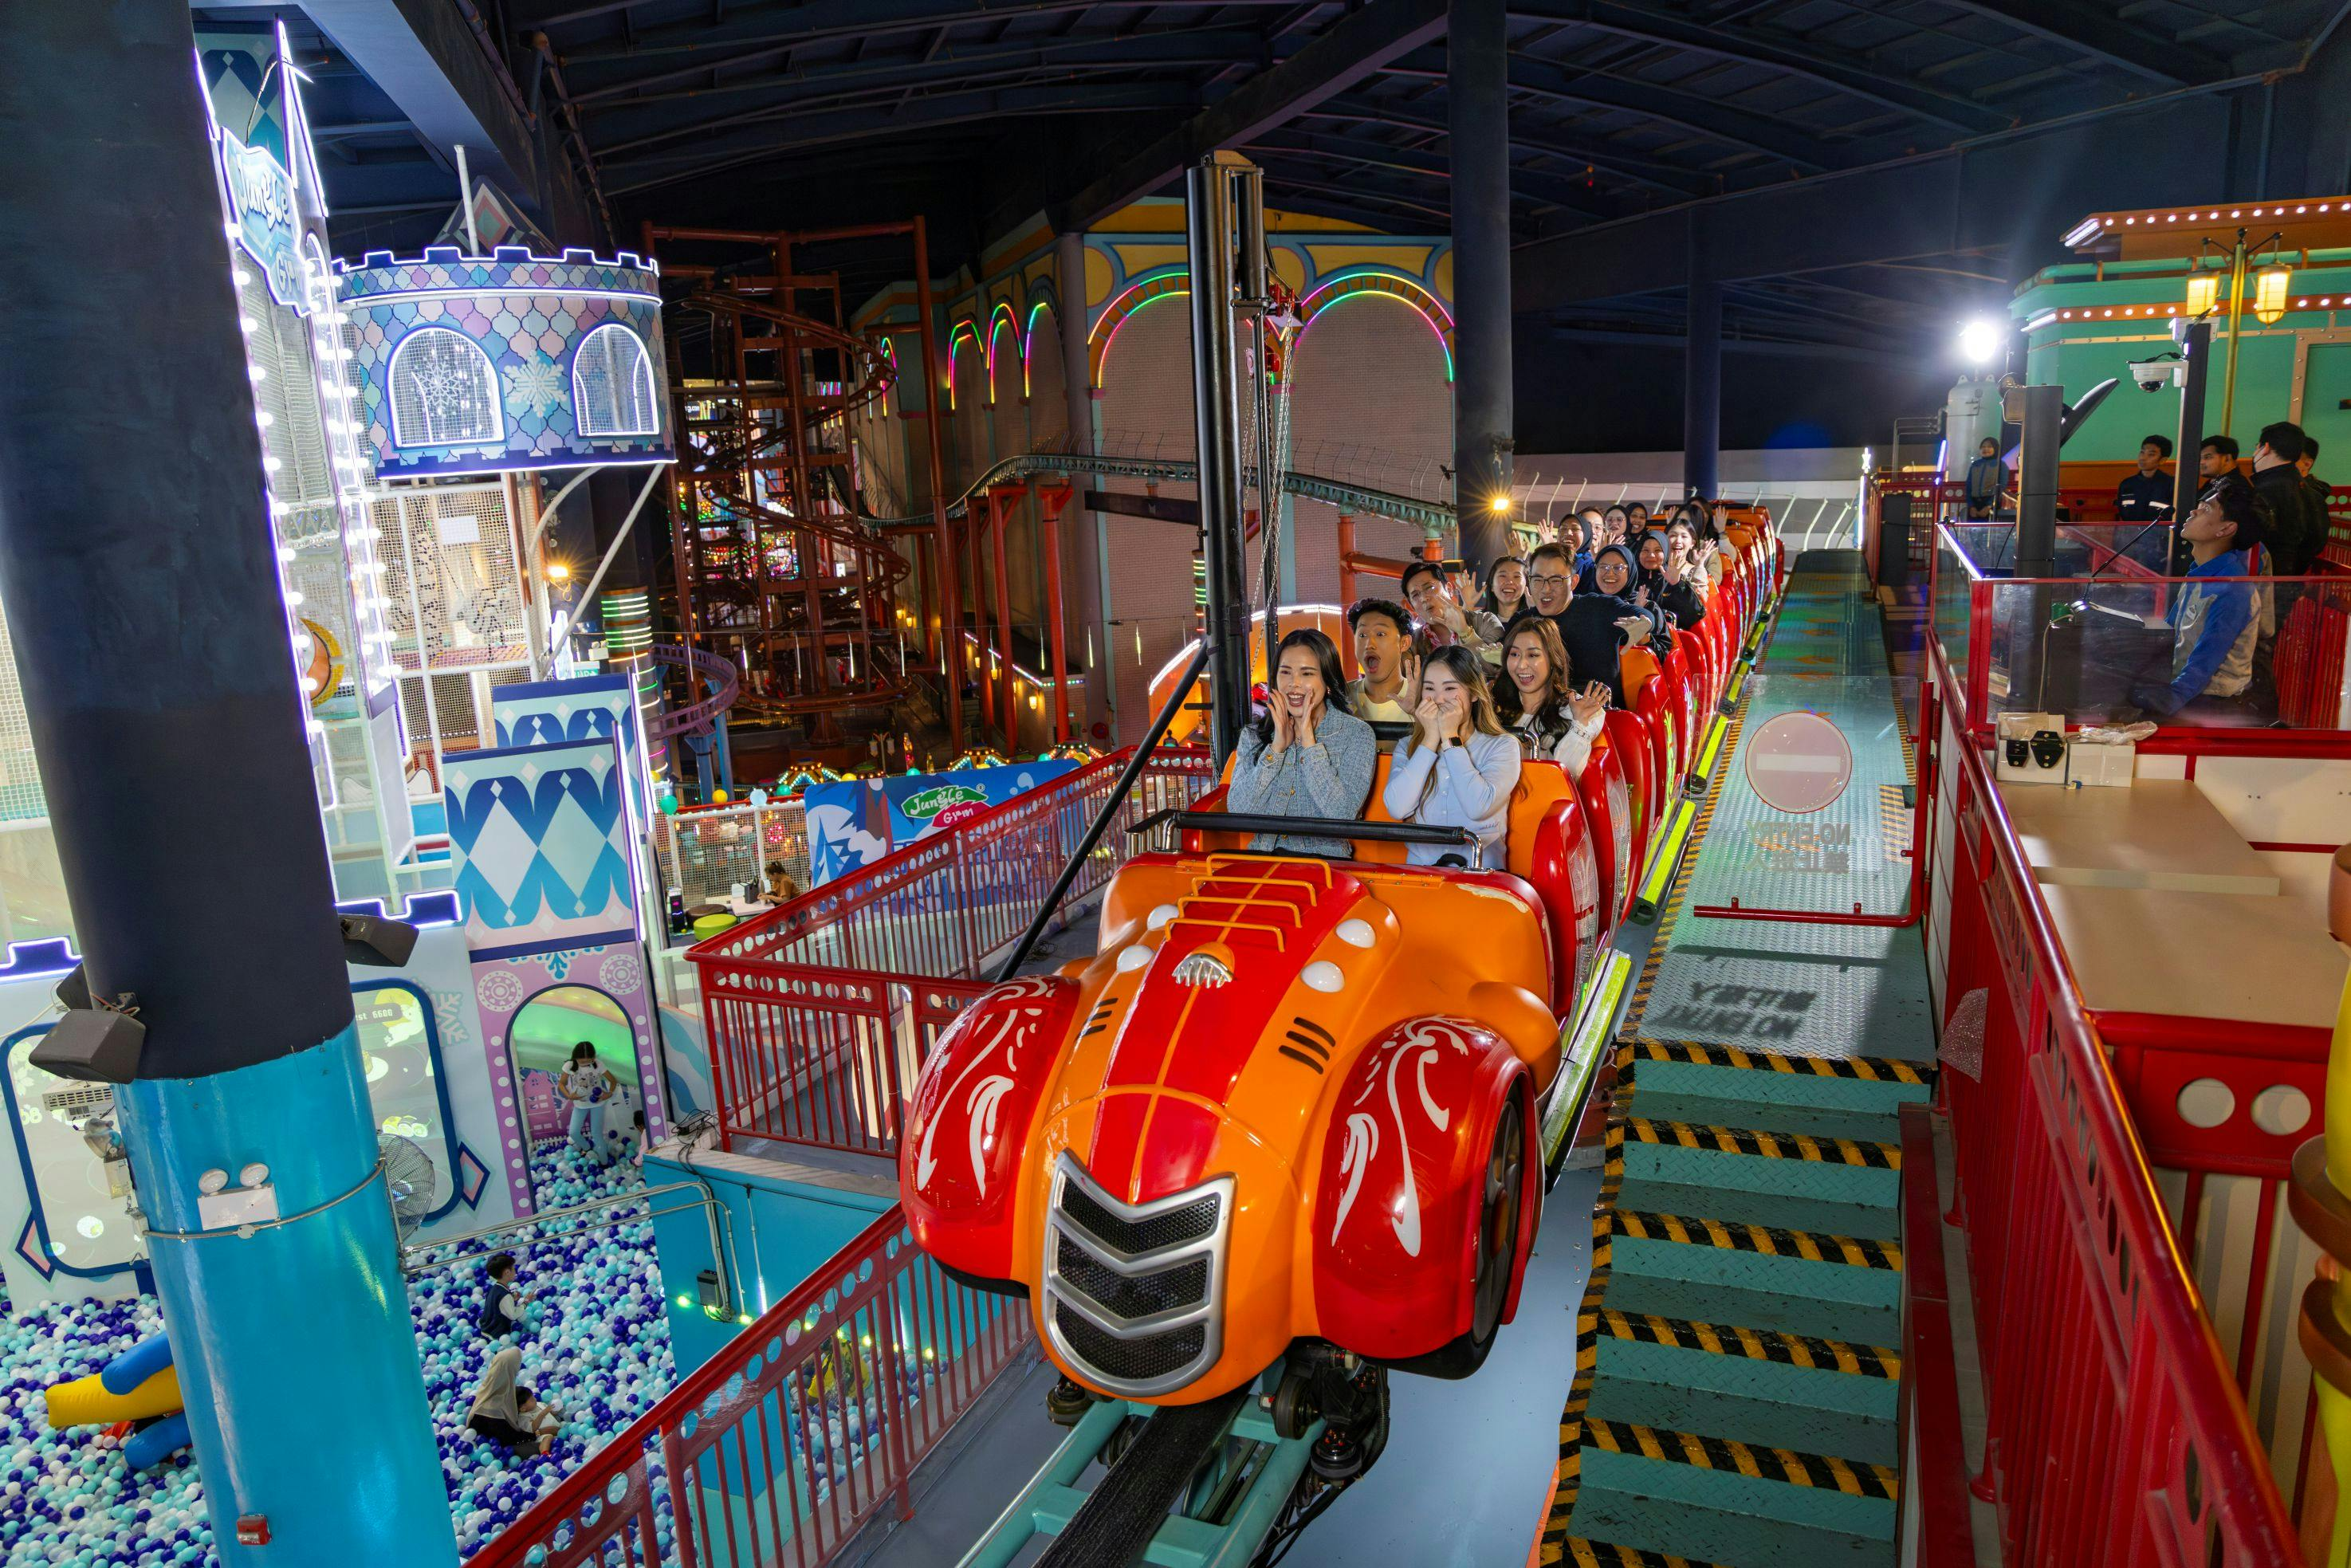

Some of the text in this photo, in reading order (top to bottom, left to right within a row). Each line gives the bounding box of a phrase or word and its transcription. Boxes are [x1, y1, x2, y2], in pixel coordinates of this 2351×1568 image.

[237, 153, 291, 230] Jungle
[910, 788, 964, 815] Jungle
[943, 808, 973, 823] Gym
